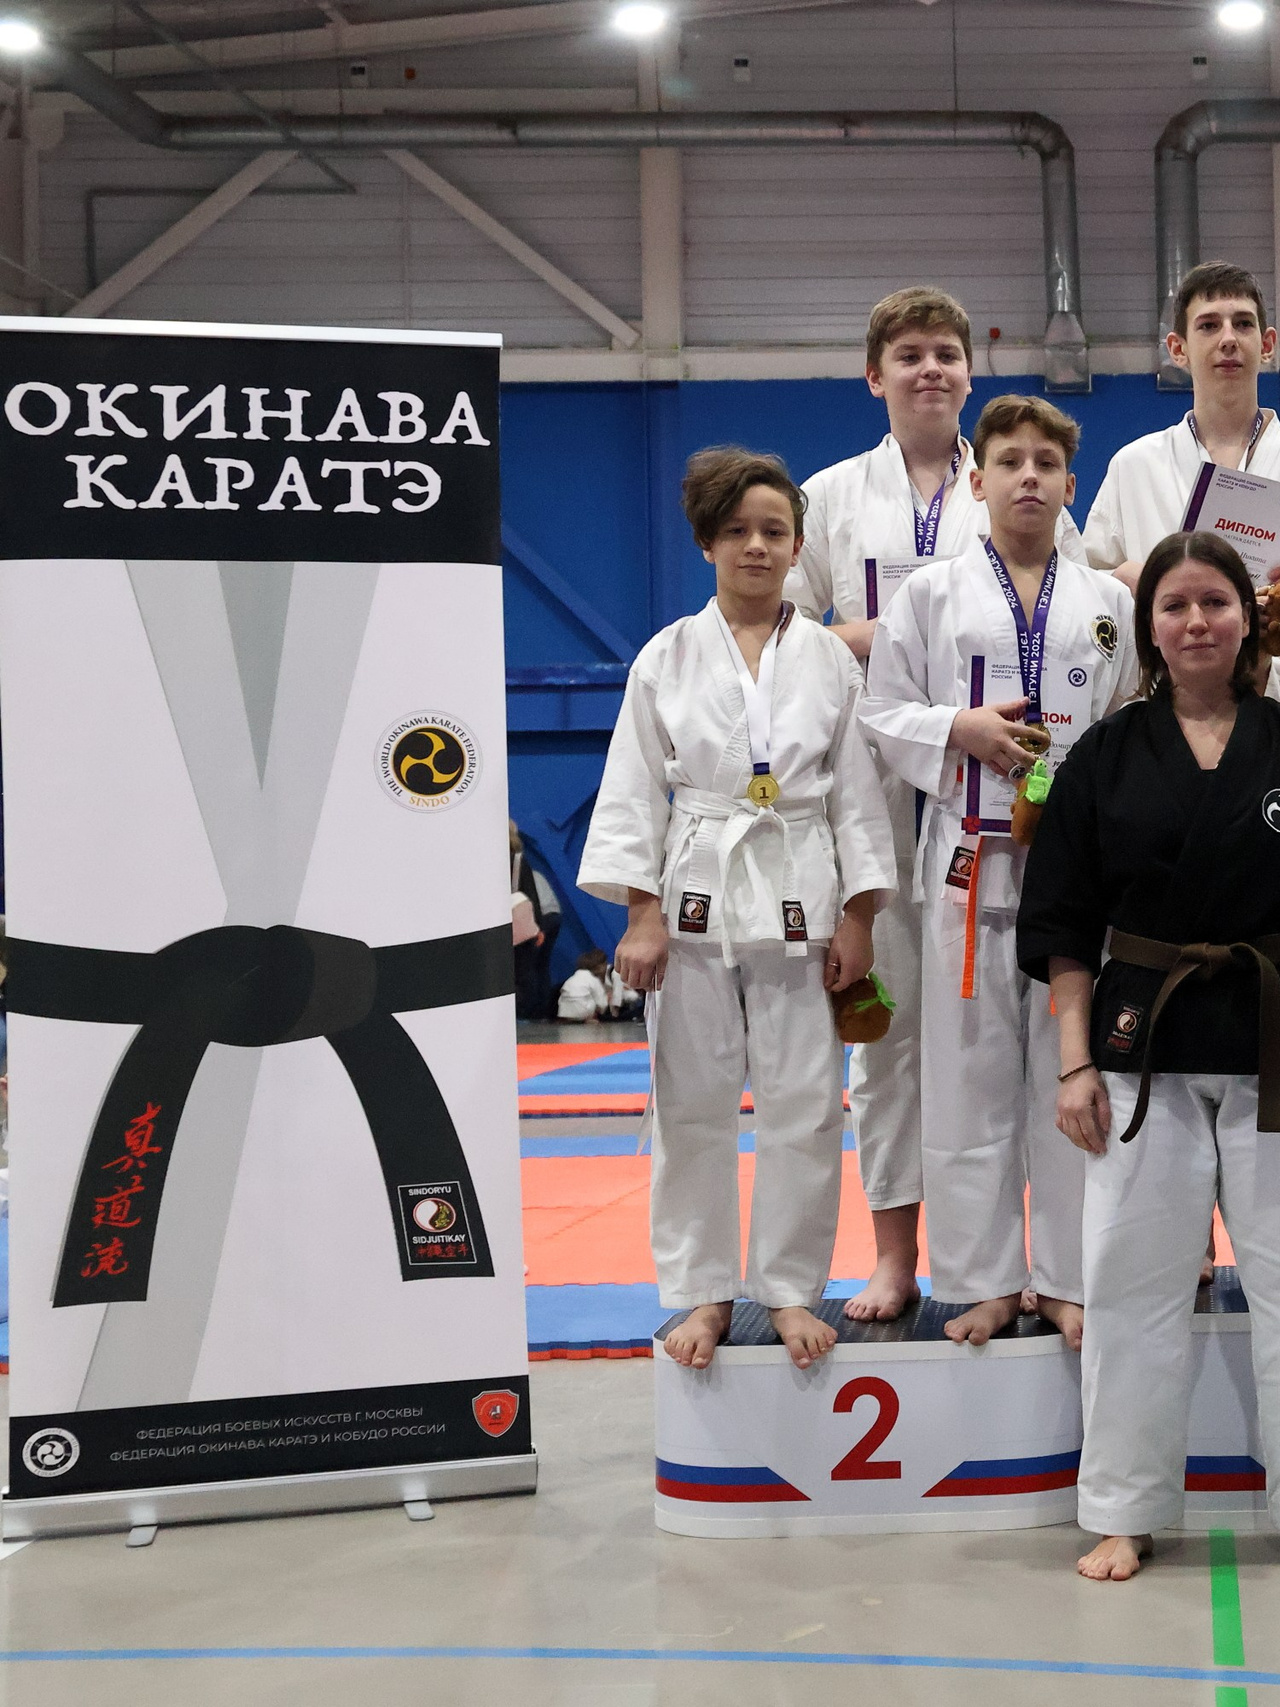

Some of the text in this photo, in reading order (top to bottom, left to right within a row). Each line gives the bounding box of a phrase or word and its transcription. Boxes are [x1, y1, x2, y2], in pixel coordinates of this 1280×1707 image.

[4, 380, 492, 446] ОКИНАВА
[63, 453, 443, 514] КАРАТЭ
[923, 520, 936, 556] ЭГУМИ
[1214, 517, 1276, 542] ДИПЛОМ
[988, 550, 1019, 609] ТЭГУМИ 2024
[1038, 574, 1054, 609] ТЭГУМИ
[1028, 631, 1041, 706] ТЭГУМИ 2024
[380, 716, 477, 797] THE WORLD OKINAWA KARATE FEDERATION
[409, 795, 450, 807] SINDO
[759, 787, 769, 799] 1
[408, 1186, 451, 1196] SINDORYU
[412, 1234, 466, 1244] SIDJUITIKAY
[136, 1422, 222, 1440] ФЕДЕРАЦИЯ
[225, 1418, 281, 1433] БОЕВЫХ
[284, 1413, 351, 1428] ИСКУССТВ
[365, 1407, 423, 1421] МОСКВЫ
[830, 1375, 903, 1482] 2
[110, 1423, 446, 1462] ФЕДЕРАЦИЯ ОКИНАВА КАРАТЭ И КОБУДО РОССИИ
